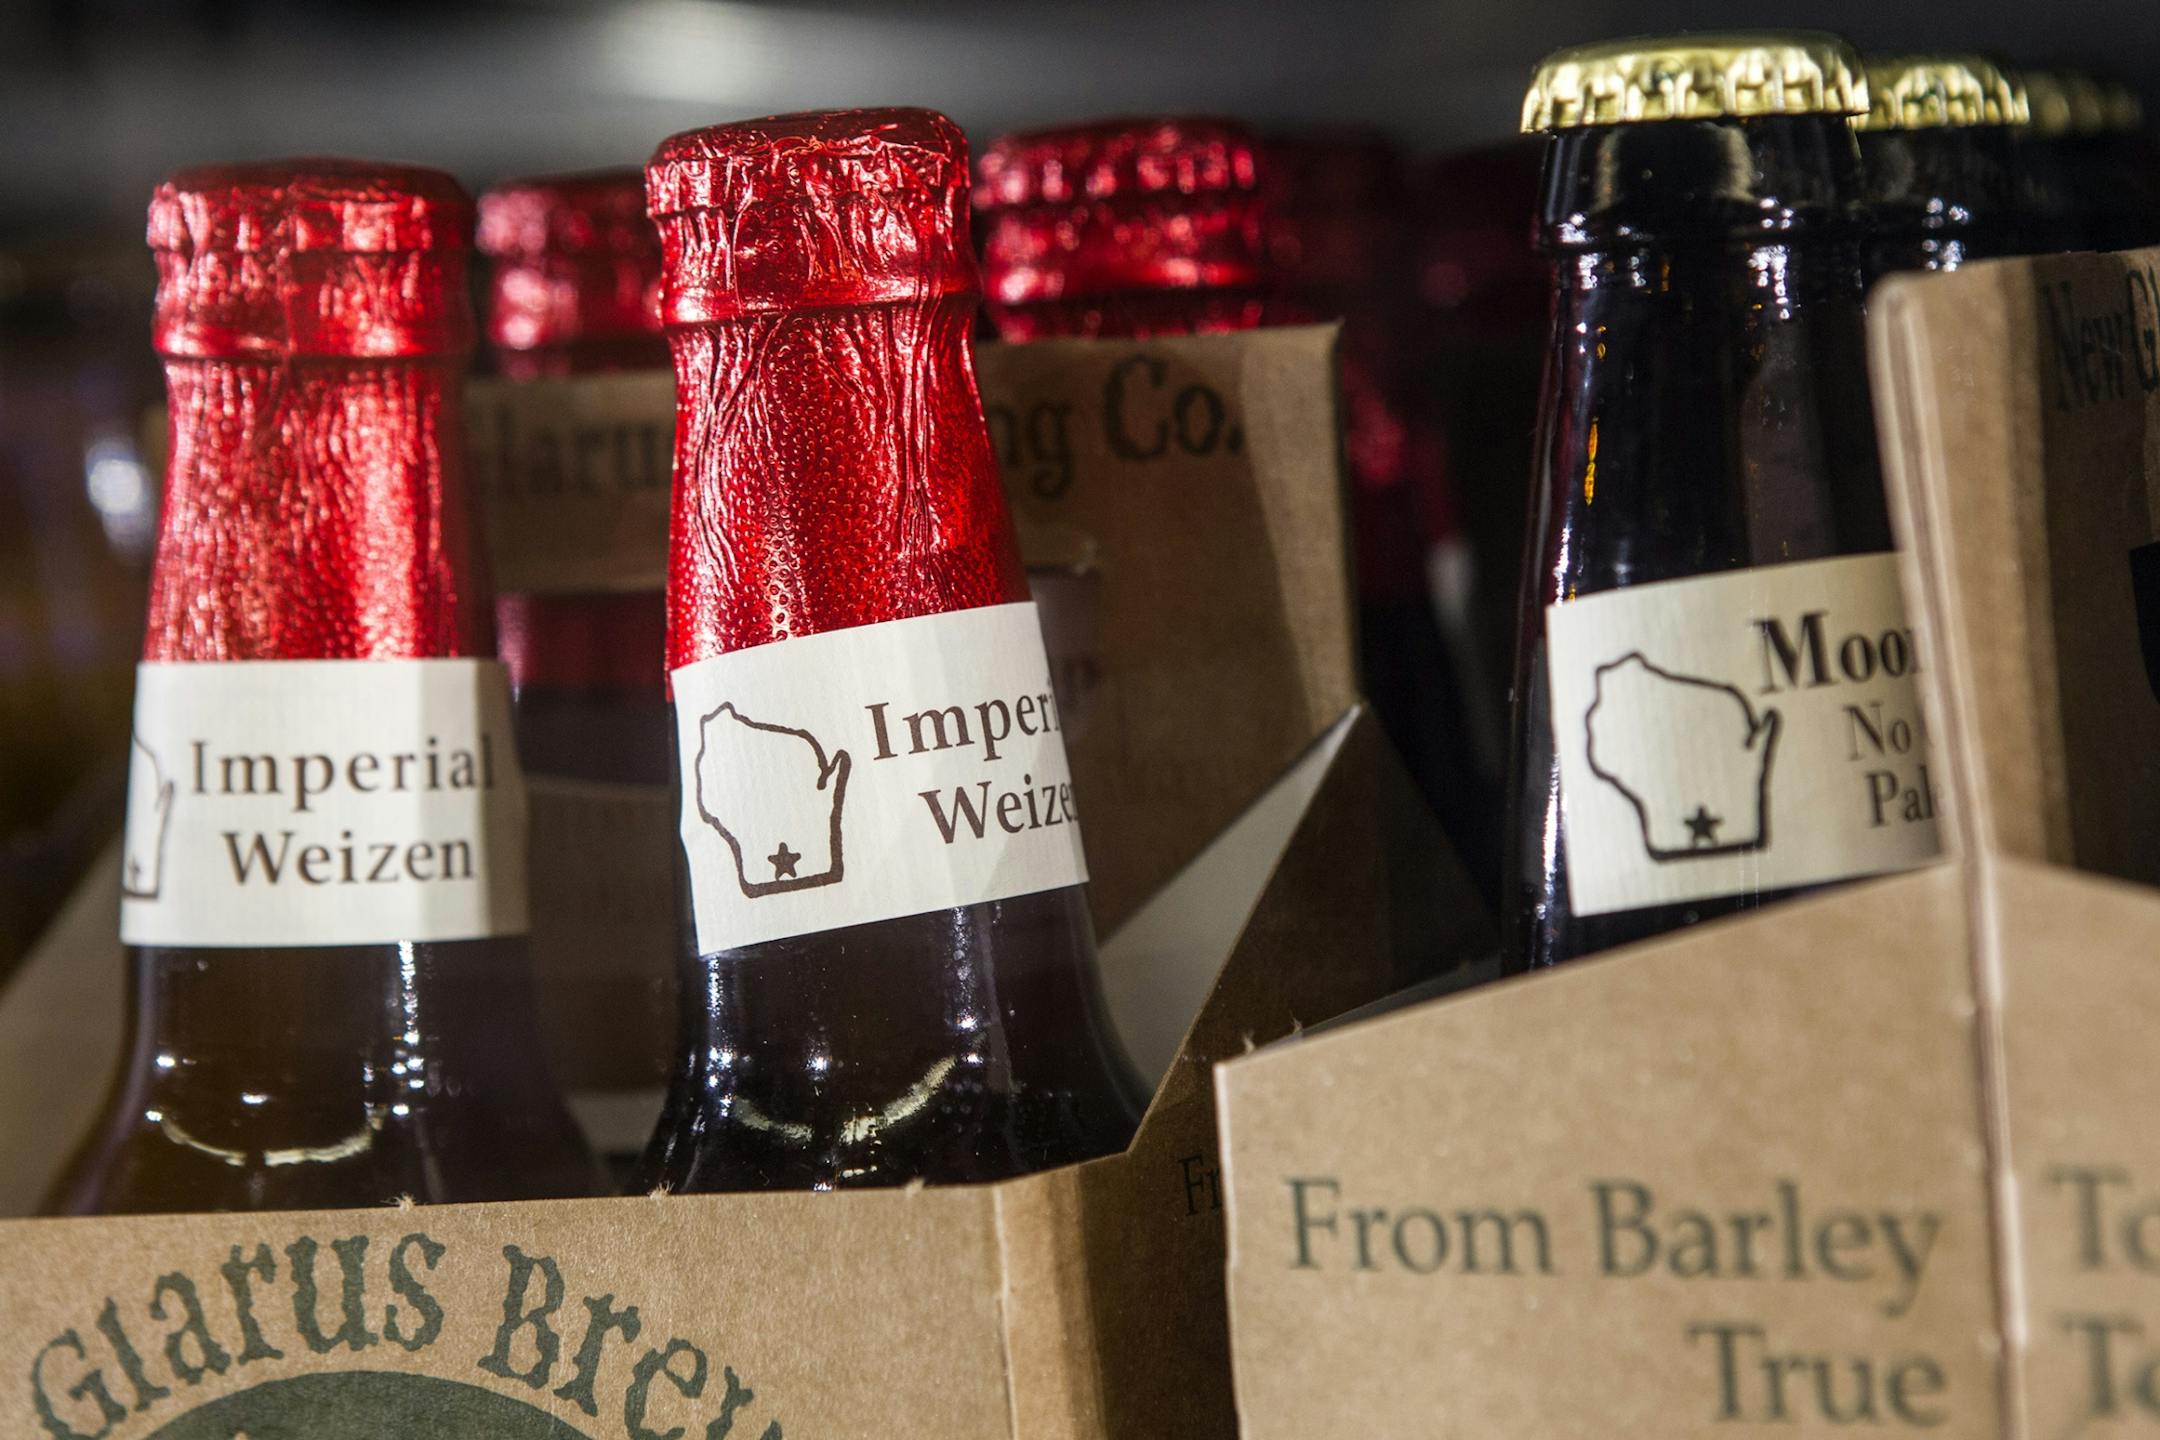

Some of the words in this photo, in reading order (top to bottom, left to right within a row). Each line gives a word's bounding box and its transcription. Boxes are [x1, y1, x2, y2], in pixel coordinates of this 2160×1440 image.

[1101, 354, 1243, 463] Co.
[1843, 699, 1912, 762] No
[190, 732, 495, 813] Imperial
[918, 773, 1079, 845] Weize
[1865, 764, 1938, 829] Pal
[223, 828, 479, 887] Weizen
[1281, 1175, 1560, 1275] From
[1587, 1177, 1943, 1318] Barley
[30, 1232, 447, 1440] Glarus
[1686, 1320, 1950, 1427] True
